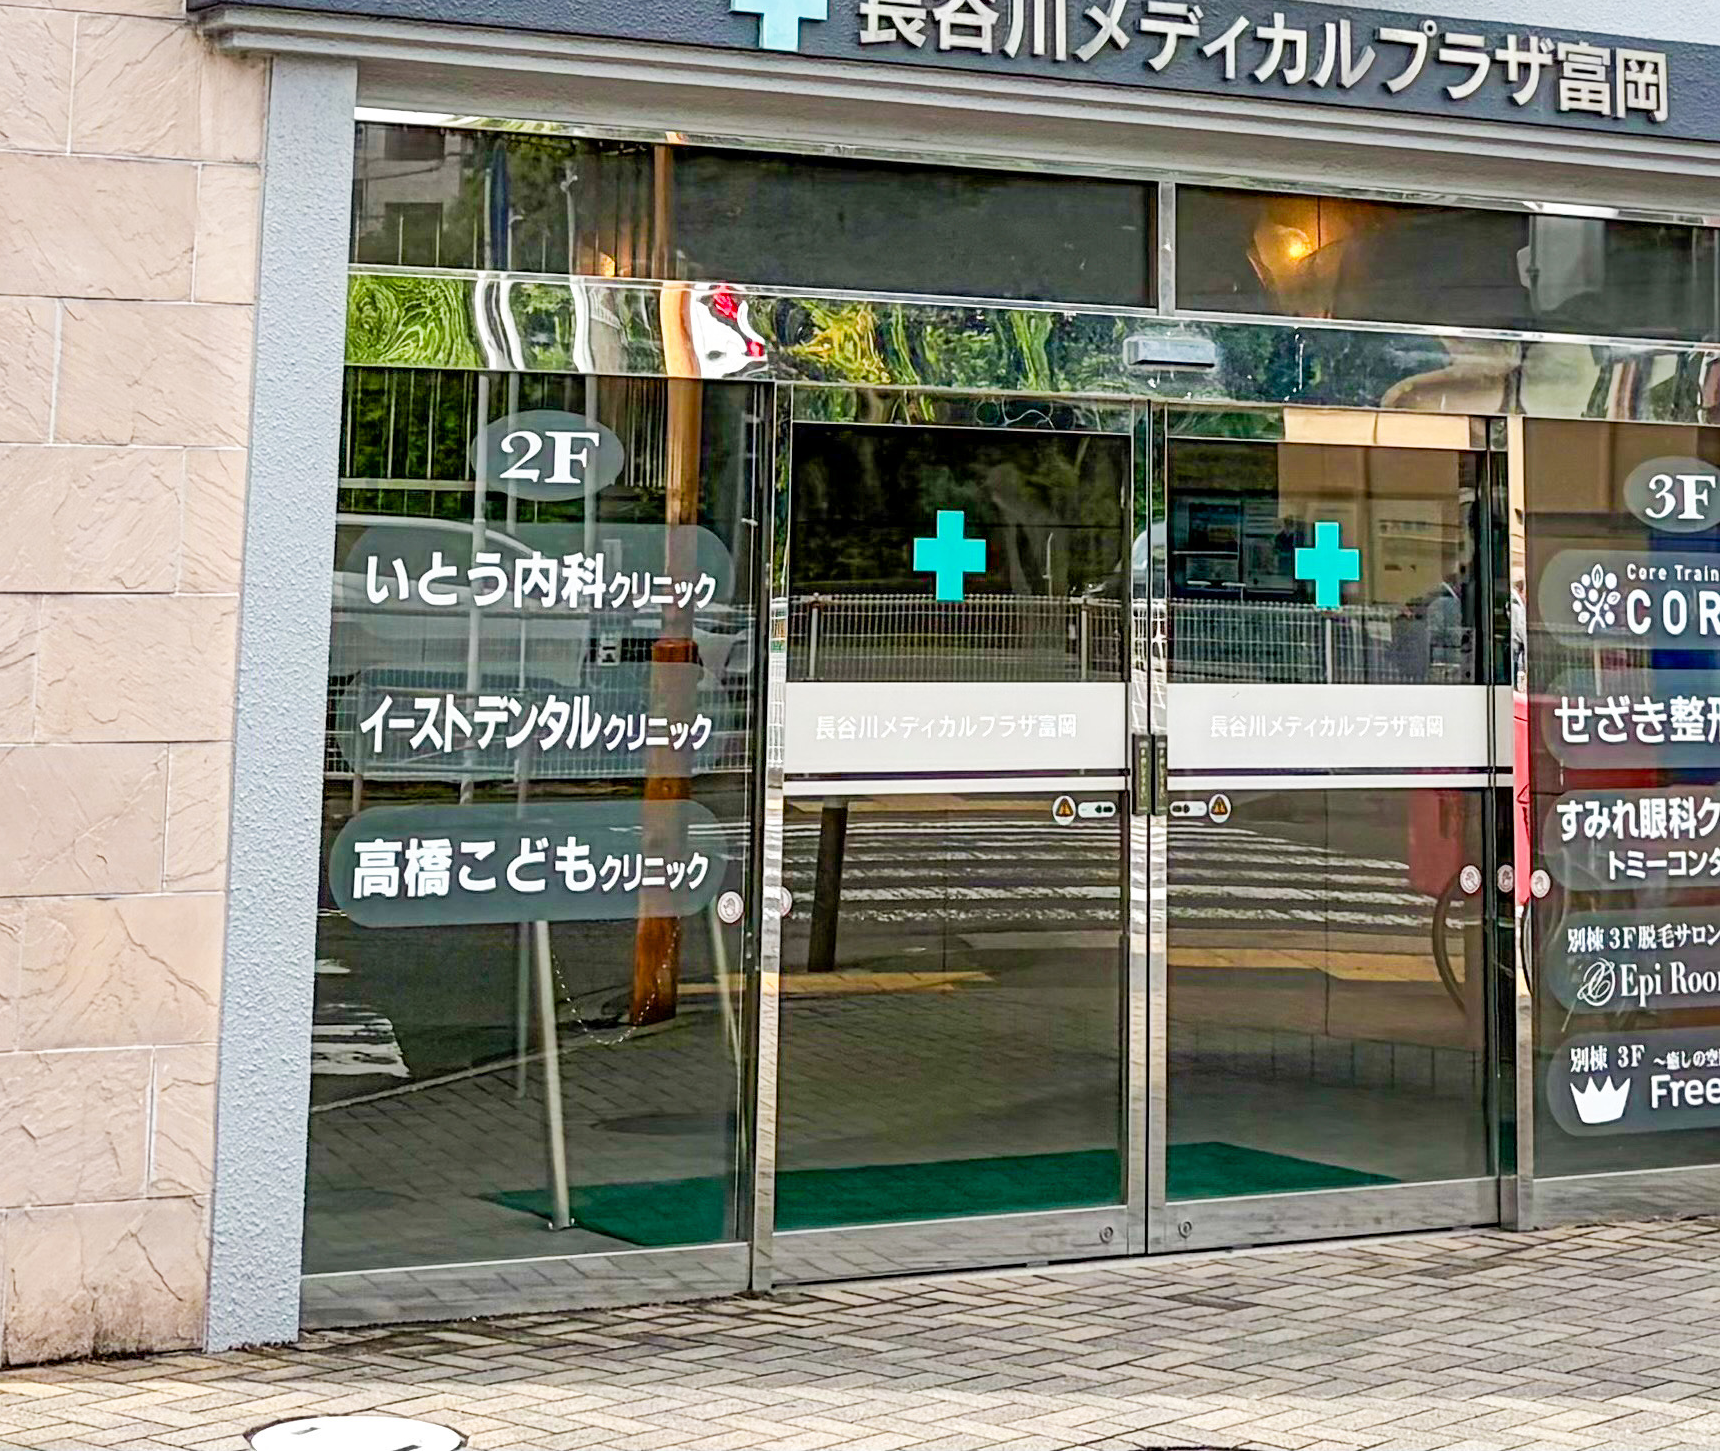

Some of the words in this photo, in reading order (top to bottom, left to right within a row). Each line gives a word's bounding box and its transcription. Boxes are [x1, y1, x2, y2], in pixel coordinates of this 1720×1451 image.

[500, 430, 600, 484] 2F
[1645, 474, 1717, 520] 3F
[366, 551, 716, 610] いとう内科クリニック
[1626, 563, 1667, 582] Core
[360, 694, 712, 754] イーストデンタルクリニック
[815, 712, 1079, 742] 長谷川メディカルプラザ富岡
[1209, 713, 1445, 740] 長谷川メディカルプラザ富岡
[352, 837, 709, 900] 高橋こどもクリニック
[1567, 925, 1605, 954] 別棟
[1620, 962, 1662, 1007] Epi
[1570, 1048, 1608, 1074] 別棟
[1617, 1045, 1646, 1067] 3F
